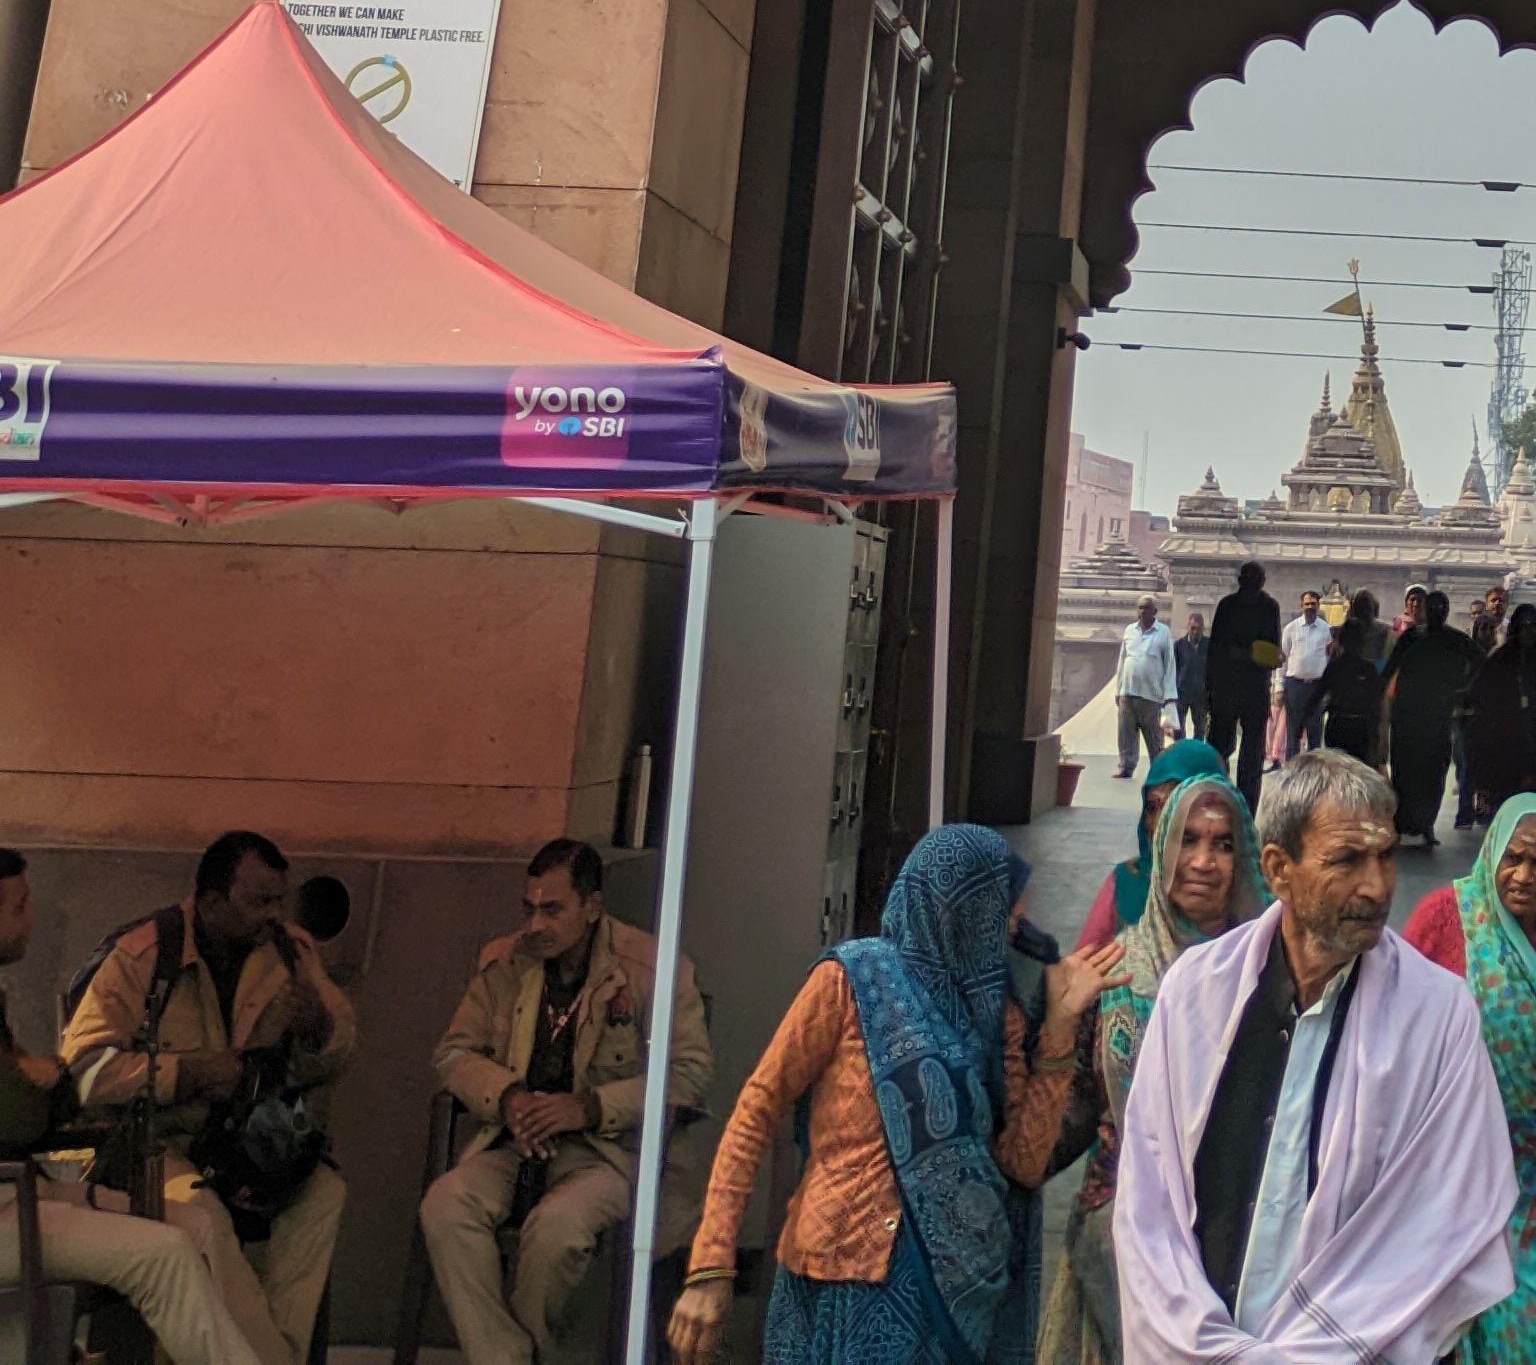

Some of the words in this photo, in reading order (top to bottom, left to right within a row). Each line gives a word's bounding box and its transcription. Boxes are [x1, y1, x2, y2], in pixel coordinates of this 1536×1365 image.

[288, 3, 336, 18] TOGETHER
[339, 6, 354, 19] WE
[356, 7, 376, 20] CAN
[377, 8, 405, 21] MAKE
[316, 23, 378, 39] VISHWANATH
[380, 27, 418, 41] TEMPLE
[419, 29, 458, 43] PLASTIC
[460, 30, 485, 44] FREE.
[515, 386, 626, 421] yono
[534, 419, 556, 436] by
[582, 416, 625, 438] SBI
